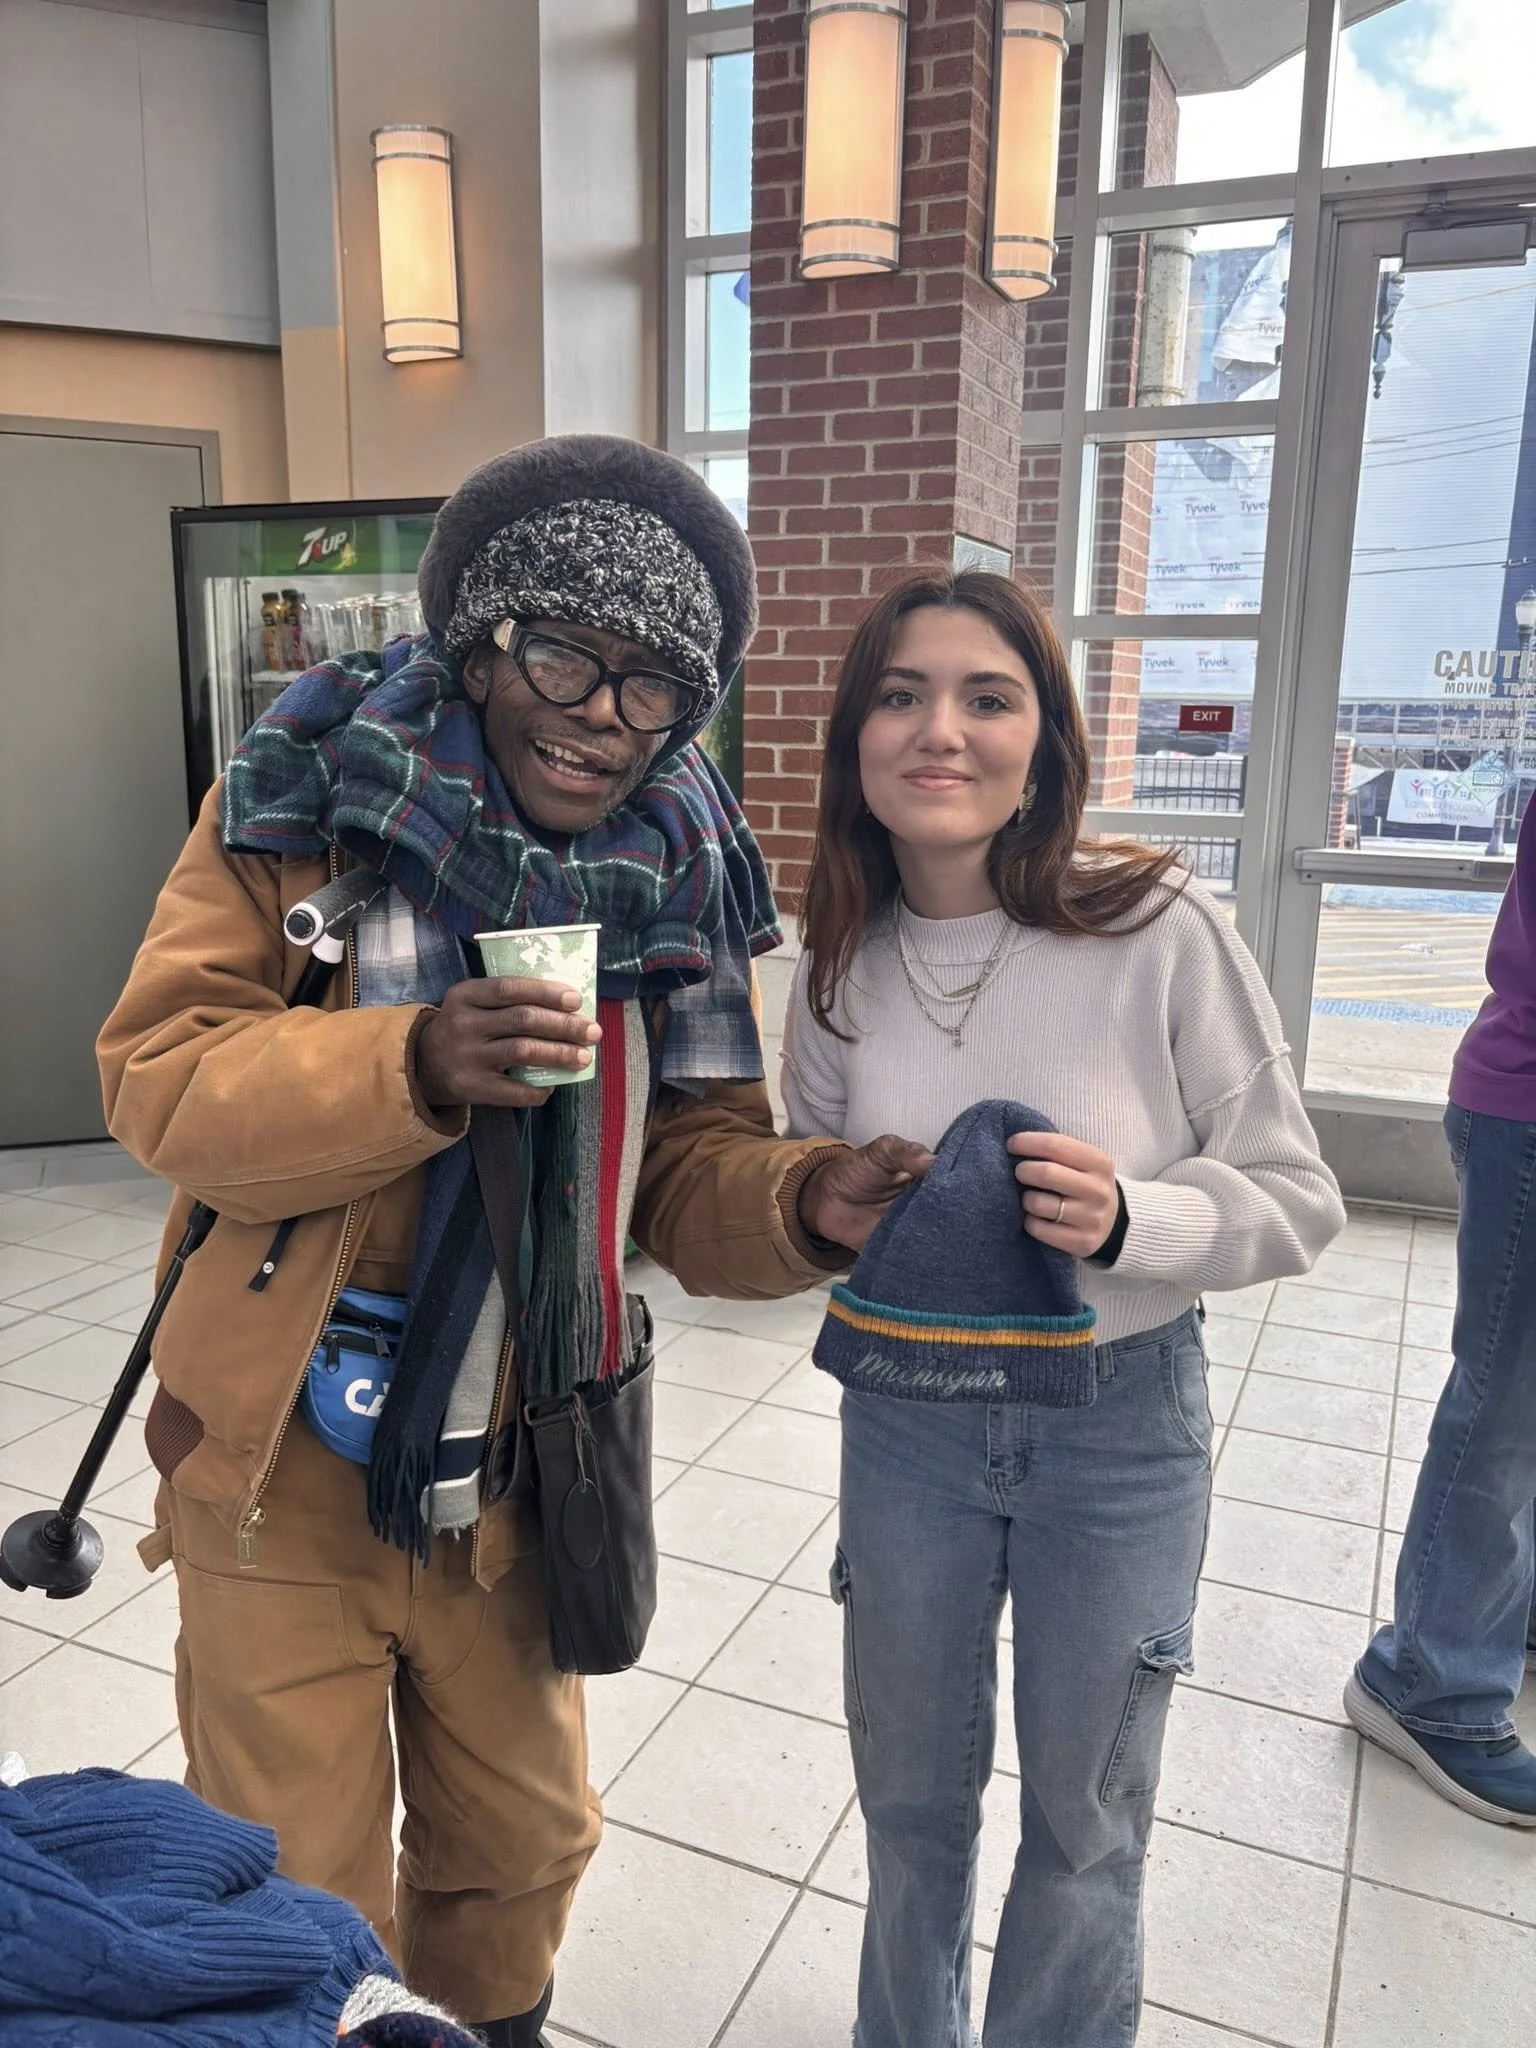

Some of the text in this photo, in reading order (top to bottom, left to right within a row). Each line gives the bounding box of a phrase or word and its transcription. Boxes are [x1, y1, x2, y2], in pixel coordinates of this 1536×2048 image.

[1258, 322, 1283, 334] Tyve
[1185, 502, 1216, 515] Tyvek
[1241, 500, 1266, 513] Tyve
[1156, 564, 1186, 576] Tyvek
[1210, 562, 1242, 574] Tyvek
[1145, 657, 1175, 668] Tyvek
[1198, 657, 1229, 669] Tyvek
[1434, 650, 1536, 678] CAUTI
[1444, 682, 1496, 695] MOVING
[1192, 710, 1221, 721] EXIT
[1416, 811, 1469, 821] COMMISSION
